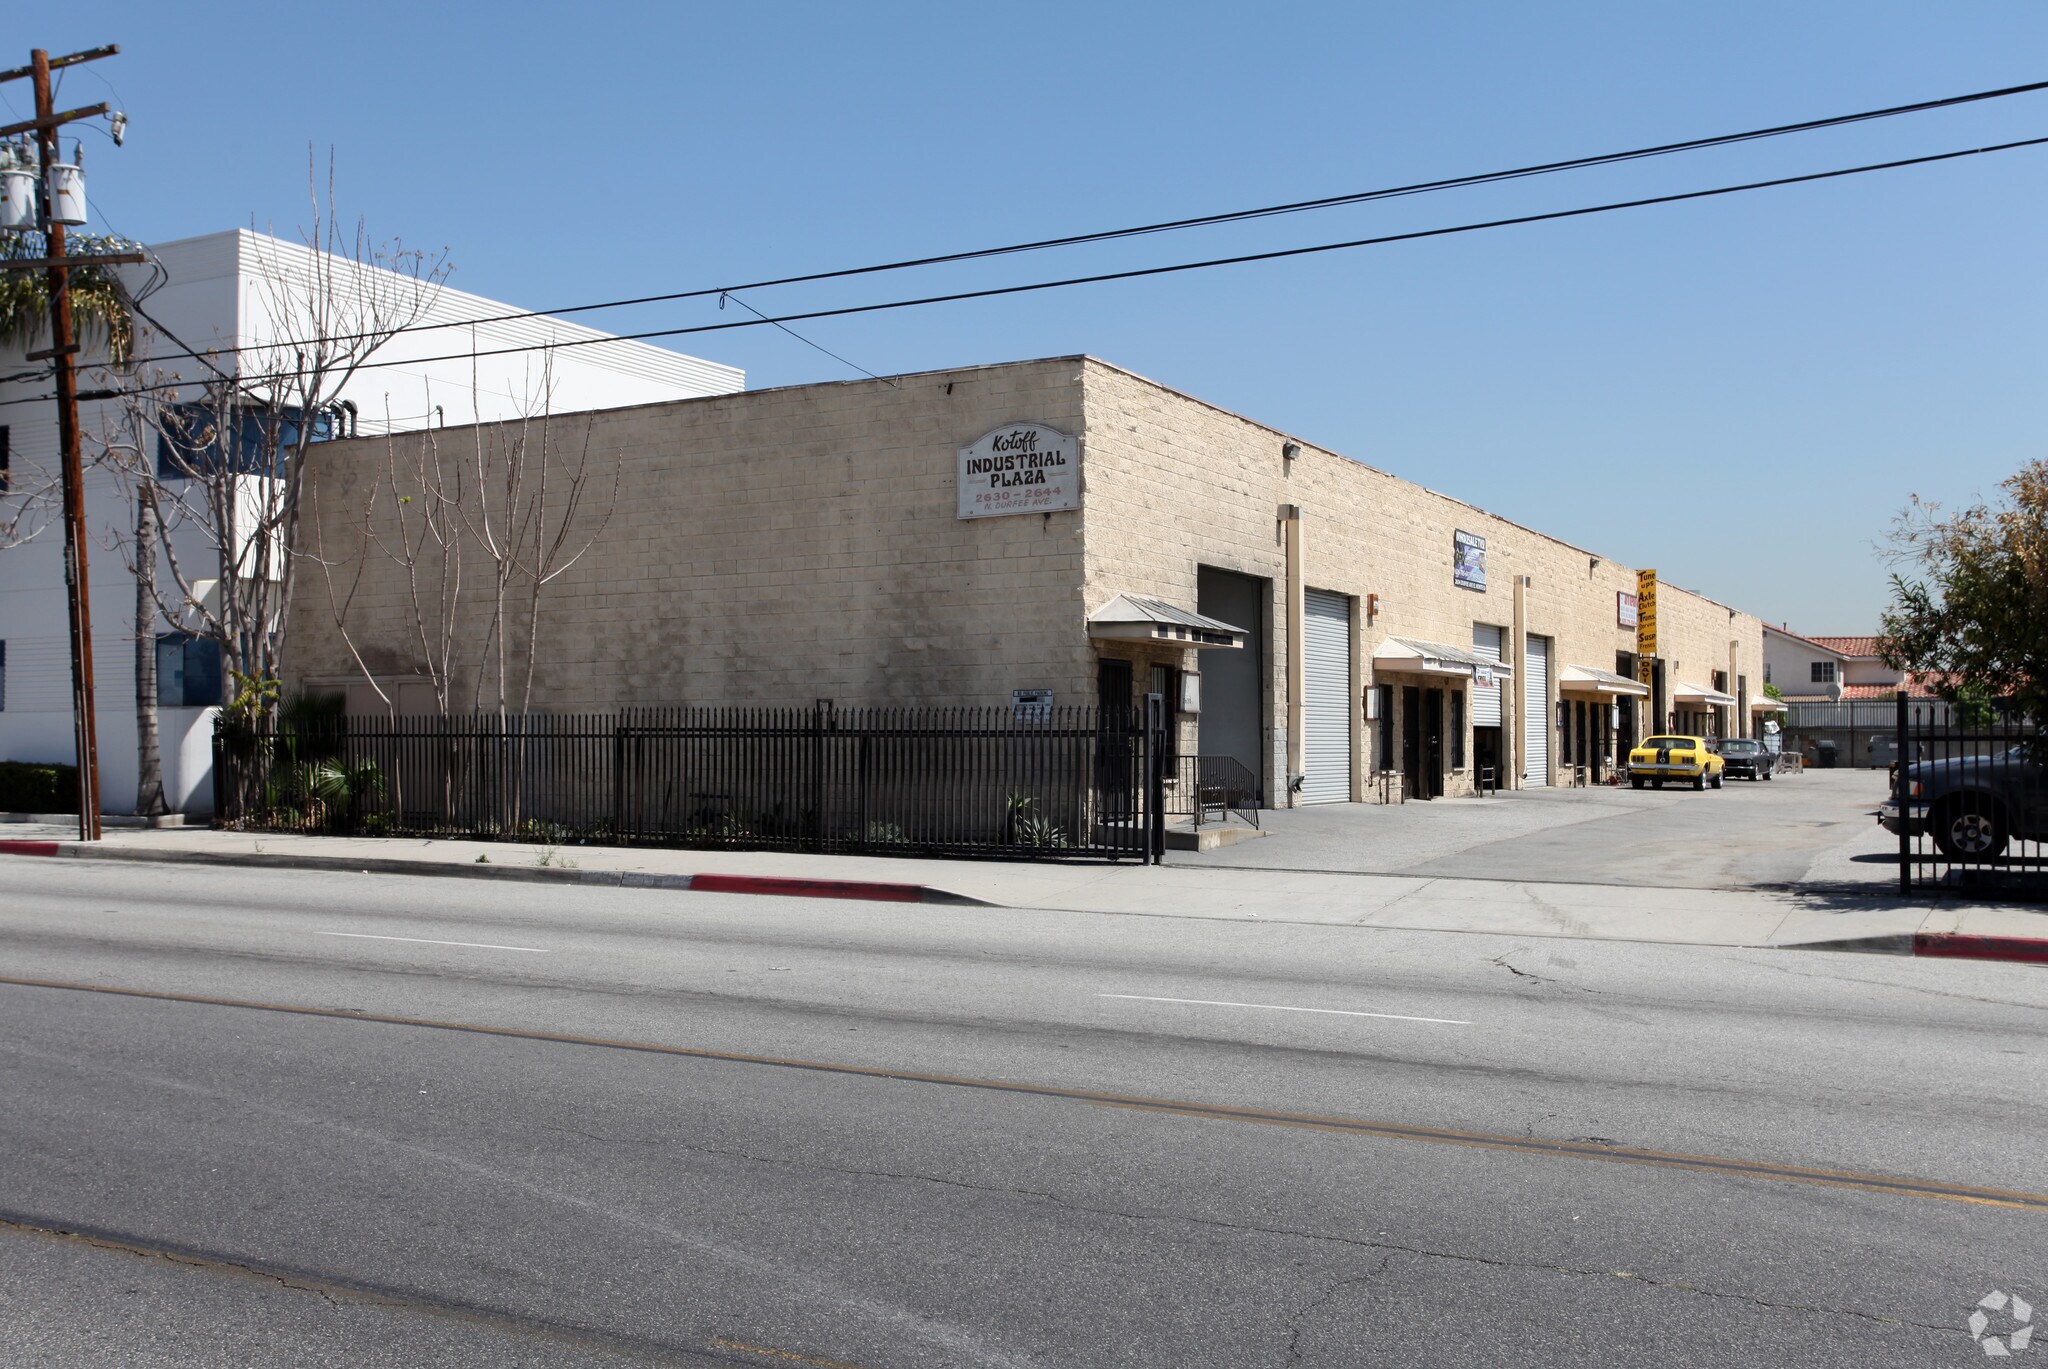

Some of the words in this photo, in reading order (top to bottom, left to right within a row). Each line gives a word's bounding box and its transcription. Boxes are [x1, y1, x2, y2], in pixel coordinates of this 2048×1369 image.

[992, 430, 1040, 452] Kotoff
[967, 450, 1066, 475] INDUSTRIAL
[990, 469, 1046, 488] PLAZA
[975, 491, 1010, 503] 2630
[1024, 486, 1062, 498] 2644
[984, 502, 993, 510] N.
[995, 499, 1030, 509] DURFEE
[1032, 497, 1052, 506] AVE.
[1638, 571, 1656, 582] Tune
[1641, 580, 1654, 589] ups
[1638, 592, 1655, 602] Axle
[1638, 601, 1656, 610] Clutch
